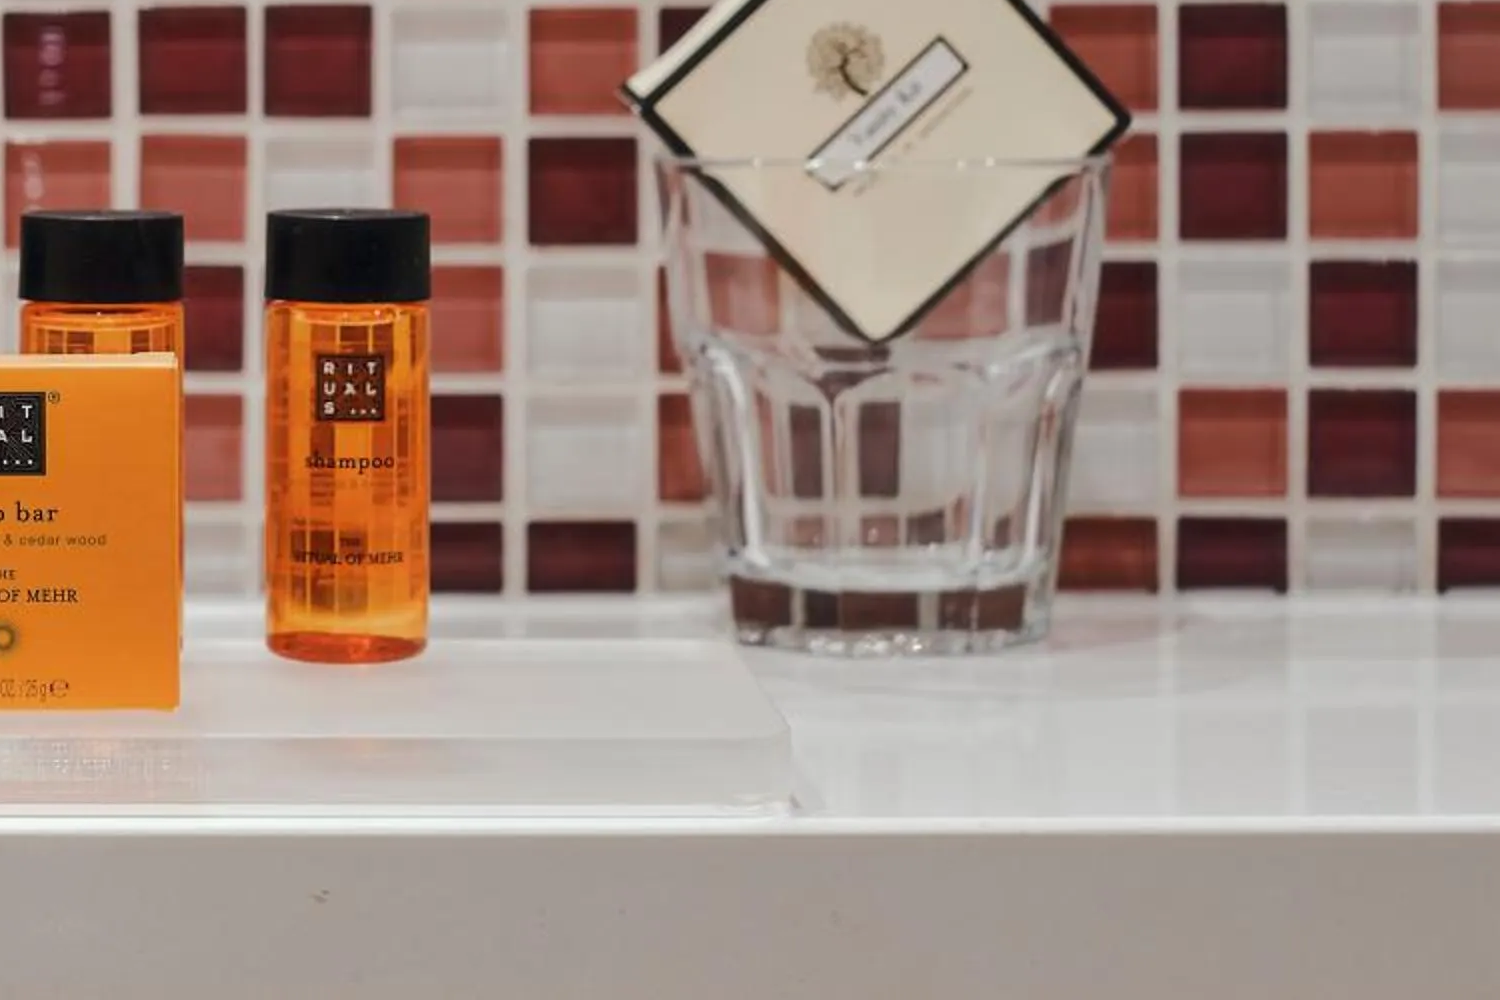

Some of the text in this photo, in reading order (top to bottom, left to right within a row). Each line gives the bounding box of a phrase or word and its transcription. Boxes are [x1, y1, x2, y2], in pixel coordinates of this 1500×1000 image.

[304, 449, 395, 475] shampoo
[15, 500, 59, 524] bar
[2, 533, 14, 547] &
[18, 533, 61, 547] cedar
[65, 533, 108, 547] wood
[26, 588, 79, 604] MEHR
